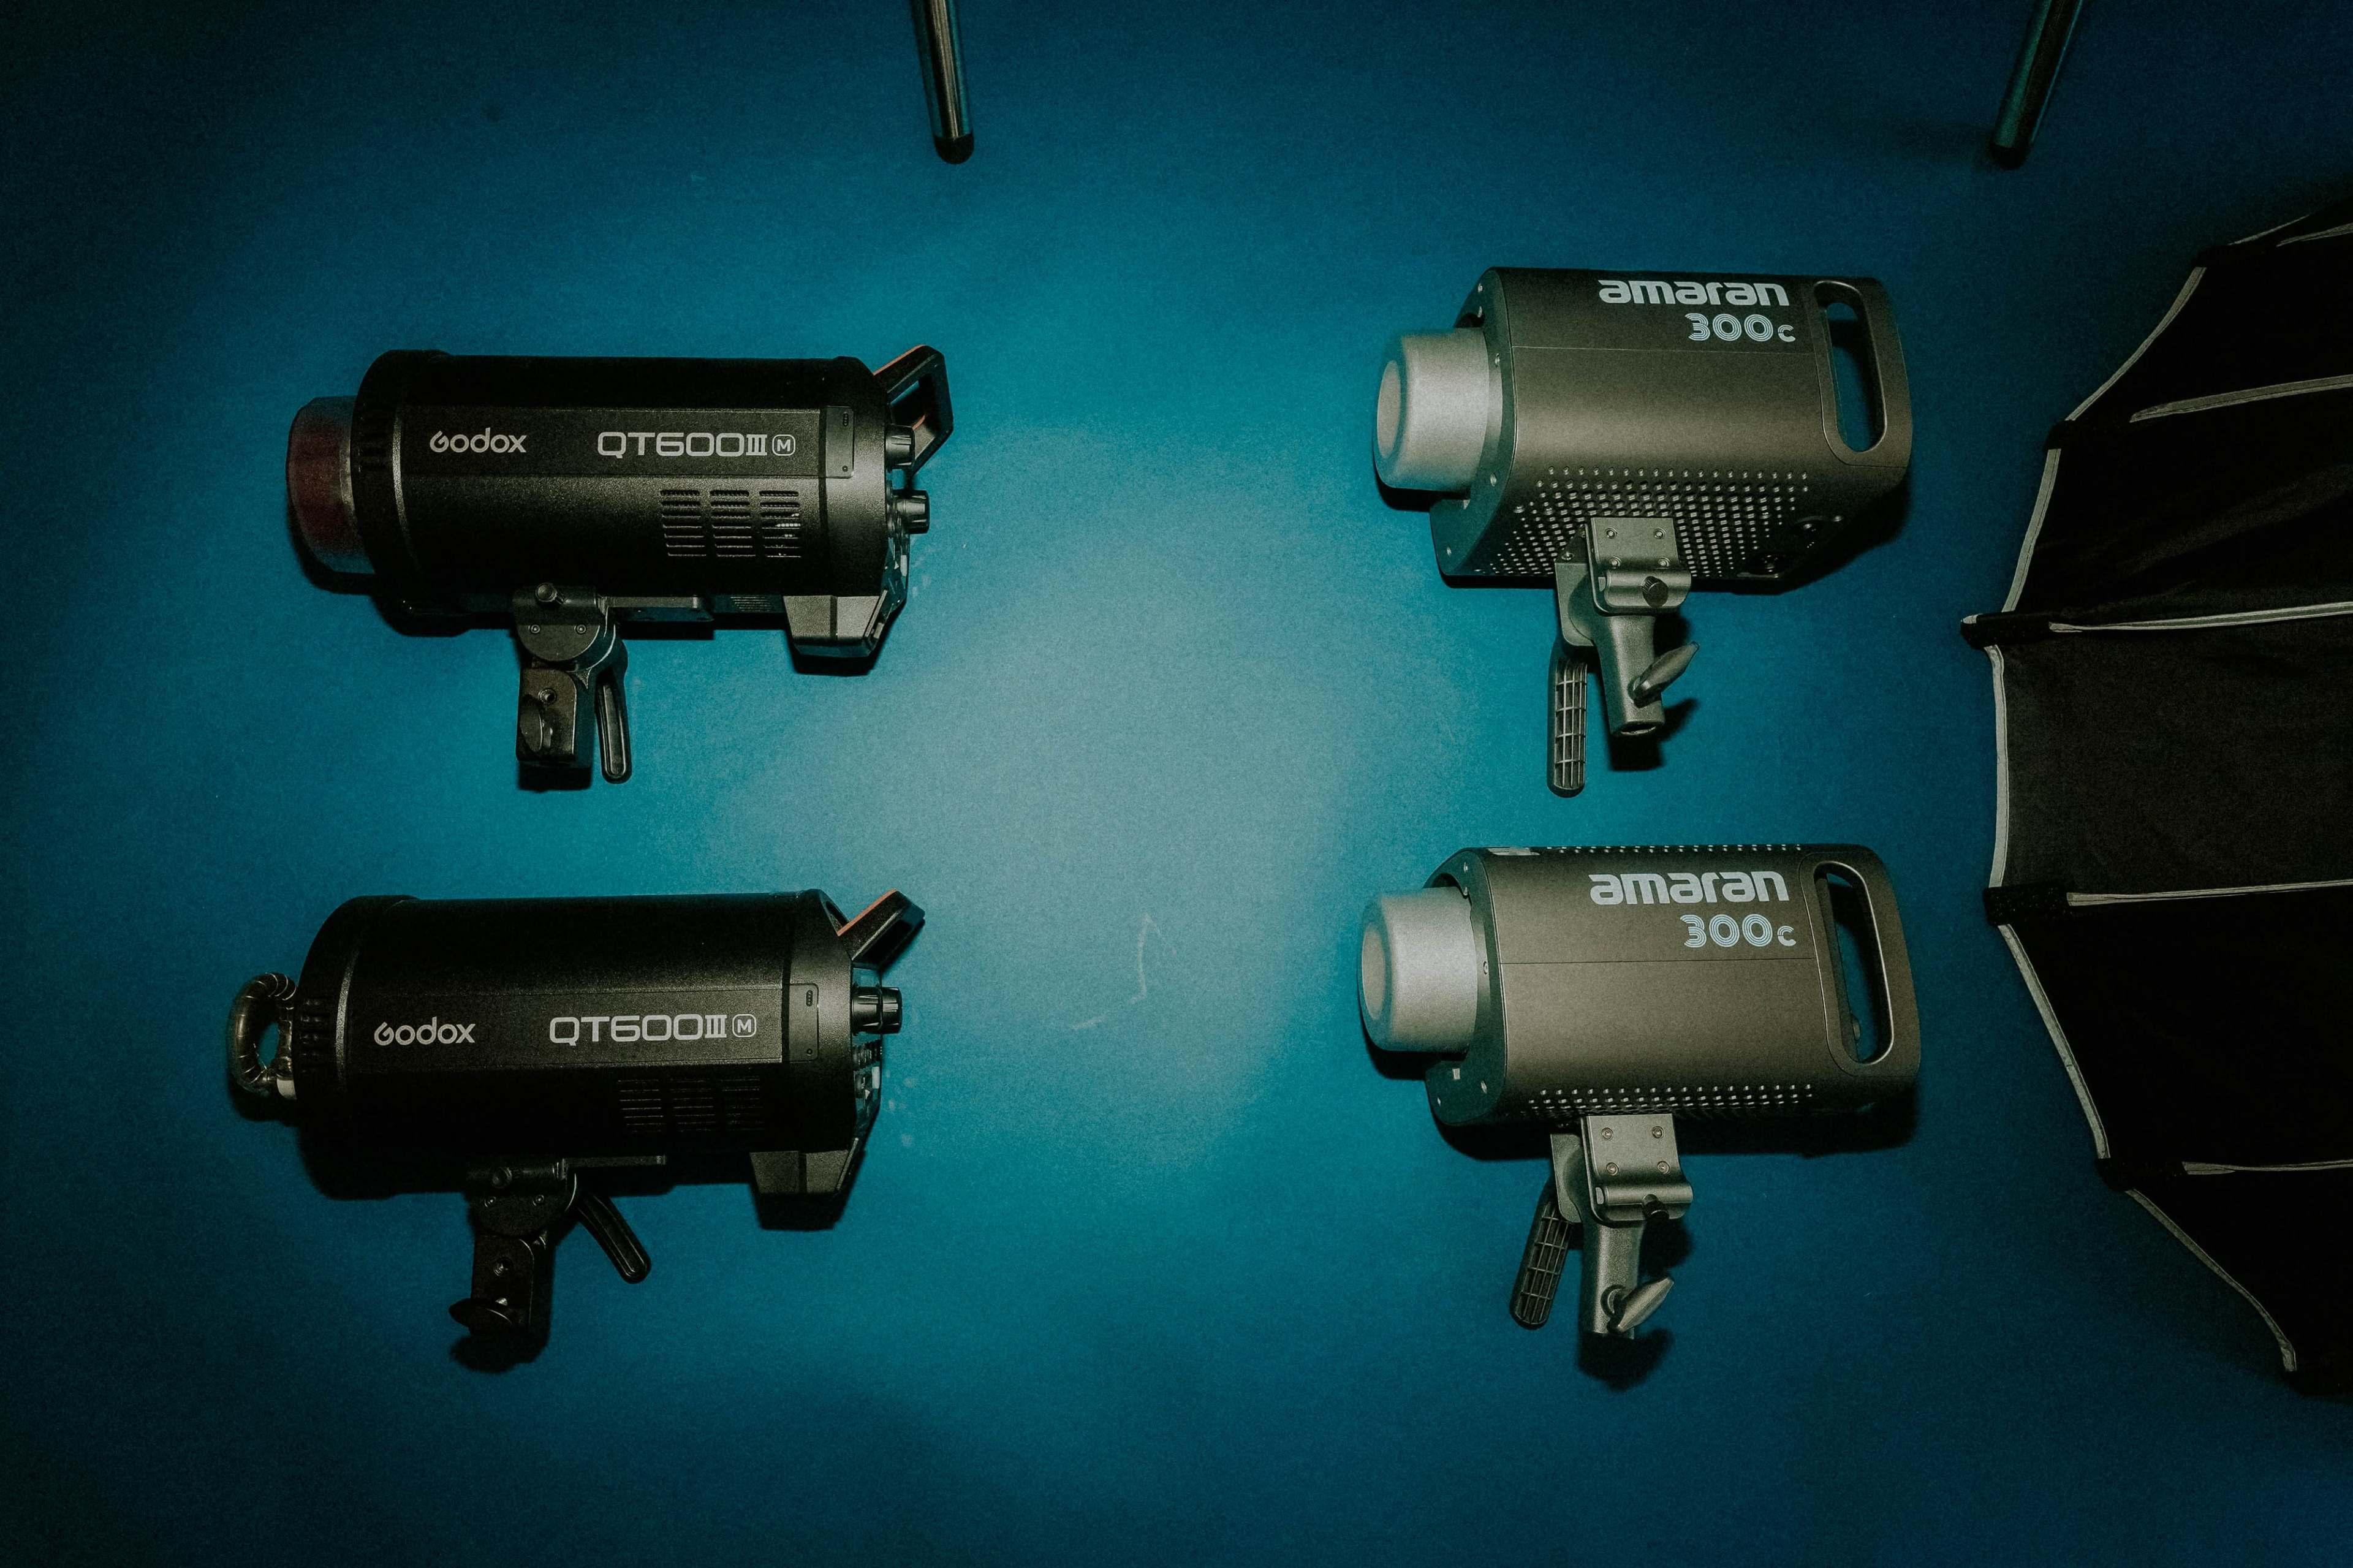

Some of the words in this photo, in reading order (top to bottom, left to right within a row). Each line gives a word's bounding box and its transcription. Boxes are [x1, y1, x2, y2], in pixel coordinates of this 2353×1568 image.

[1597, 279, 1790, 306] amaran
[1684, 312, 1796, 343] 300c
[430, 426, 528, 453] Godox
[1588, 871, 1790, 906] amaran
[1680, 914, 1797, 948] 300c
[374, 1016, 476, 1046] Godox
